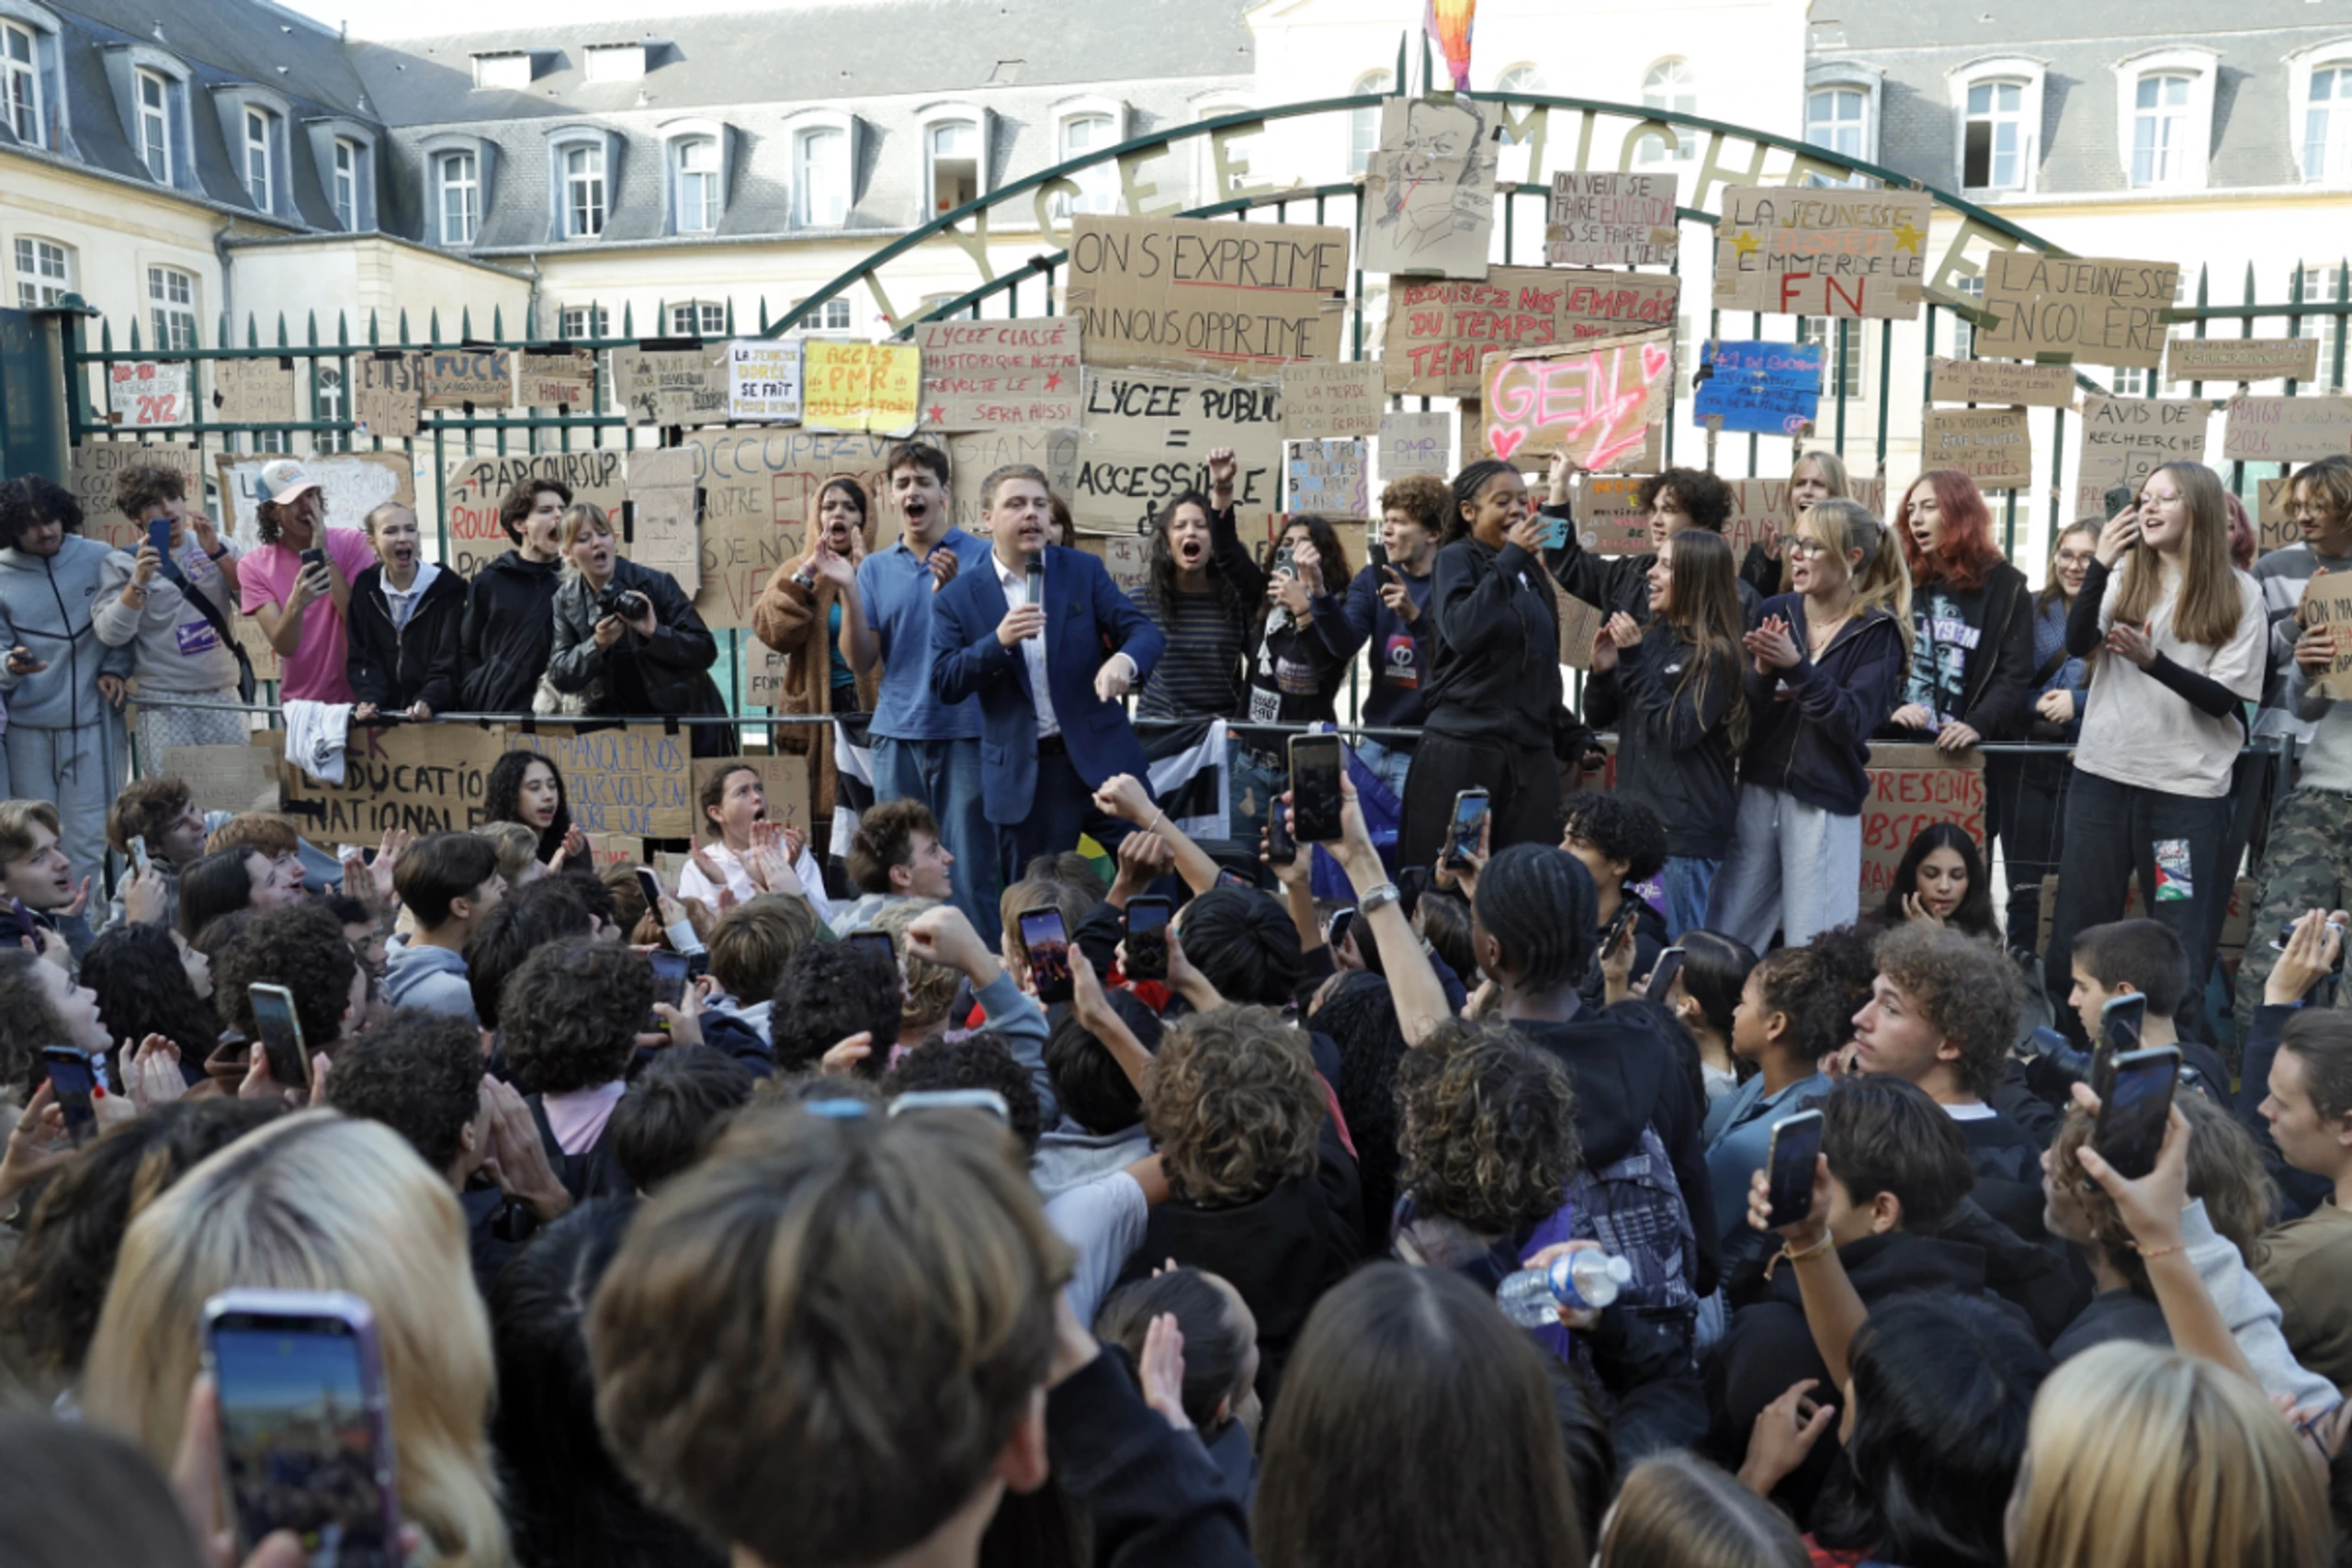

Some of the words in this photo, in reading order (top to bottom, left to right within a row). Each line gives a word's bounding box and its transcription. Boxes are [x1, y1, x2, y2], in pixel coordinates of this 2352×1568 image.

[1557, 174, 1578, 194] ON
[1586, 173, 1625, 196] VEUT
[1625, 175, 1653, 197] SE
[1555, 196, 1597, 220] FAIRE
[1734, 198, 1775, 227] LA
[1781, 199, 1918, 230] JEUNESSE
[1578, 224, 1599, 243] SE
[1604, 224, 1645, 243] FAIRE
[1073, 232, 1130, 274] ON
[1138, 232, 1343, 291] S'EXPRIME
[1891, 255, 1923, 278] LE
[2055, 262, 2179, 301] JEUNESSE
[997, 322, 1067, 347] CLASSÉ
[1069, 305, 1107, 338] ON
[1113, 308, 1182, 345] NOUS
[1409, 311, 1443, 337] DU
[1453, 310, 1555, 344] TEMPS
[1983, 298, 2037, 344] EN
[2041, 299, 2166, 353] COLÈRE
[434, 354, 509, 380] FUCK
[735, 349, 749, 362] LA
[741, 382, 758, 397] SE
[829, 366, 889, 392] PMR
[1491, 344, 1625, 425] GEN
[1088, 377, 1191, 417] LYCEE
[1200, 388, 1283, 423] PUBLIC
[2095, 402, 2153, 424] AVIS
[2162, 404, 2194, 425] DE
[2087, 431, 2204, 453] RECHERCHE
[2225, 427, 2272, 455] 2026
[471, 453, 617, 498] PARCOURSUP
[2307, 599, 2330, 625] ON
[643, 733, 684, 773] NOS
[662, 777, 686, 808] EN
